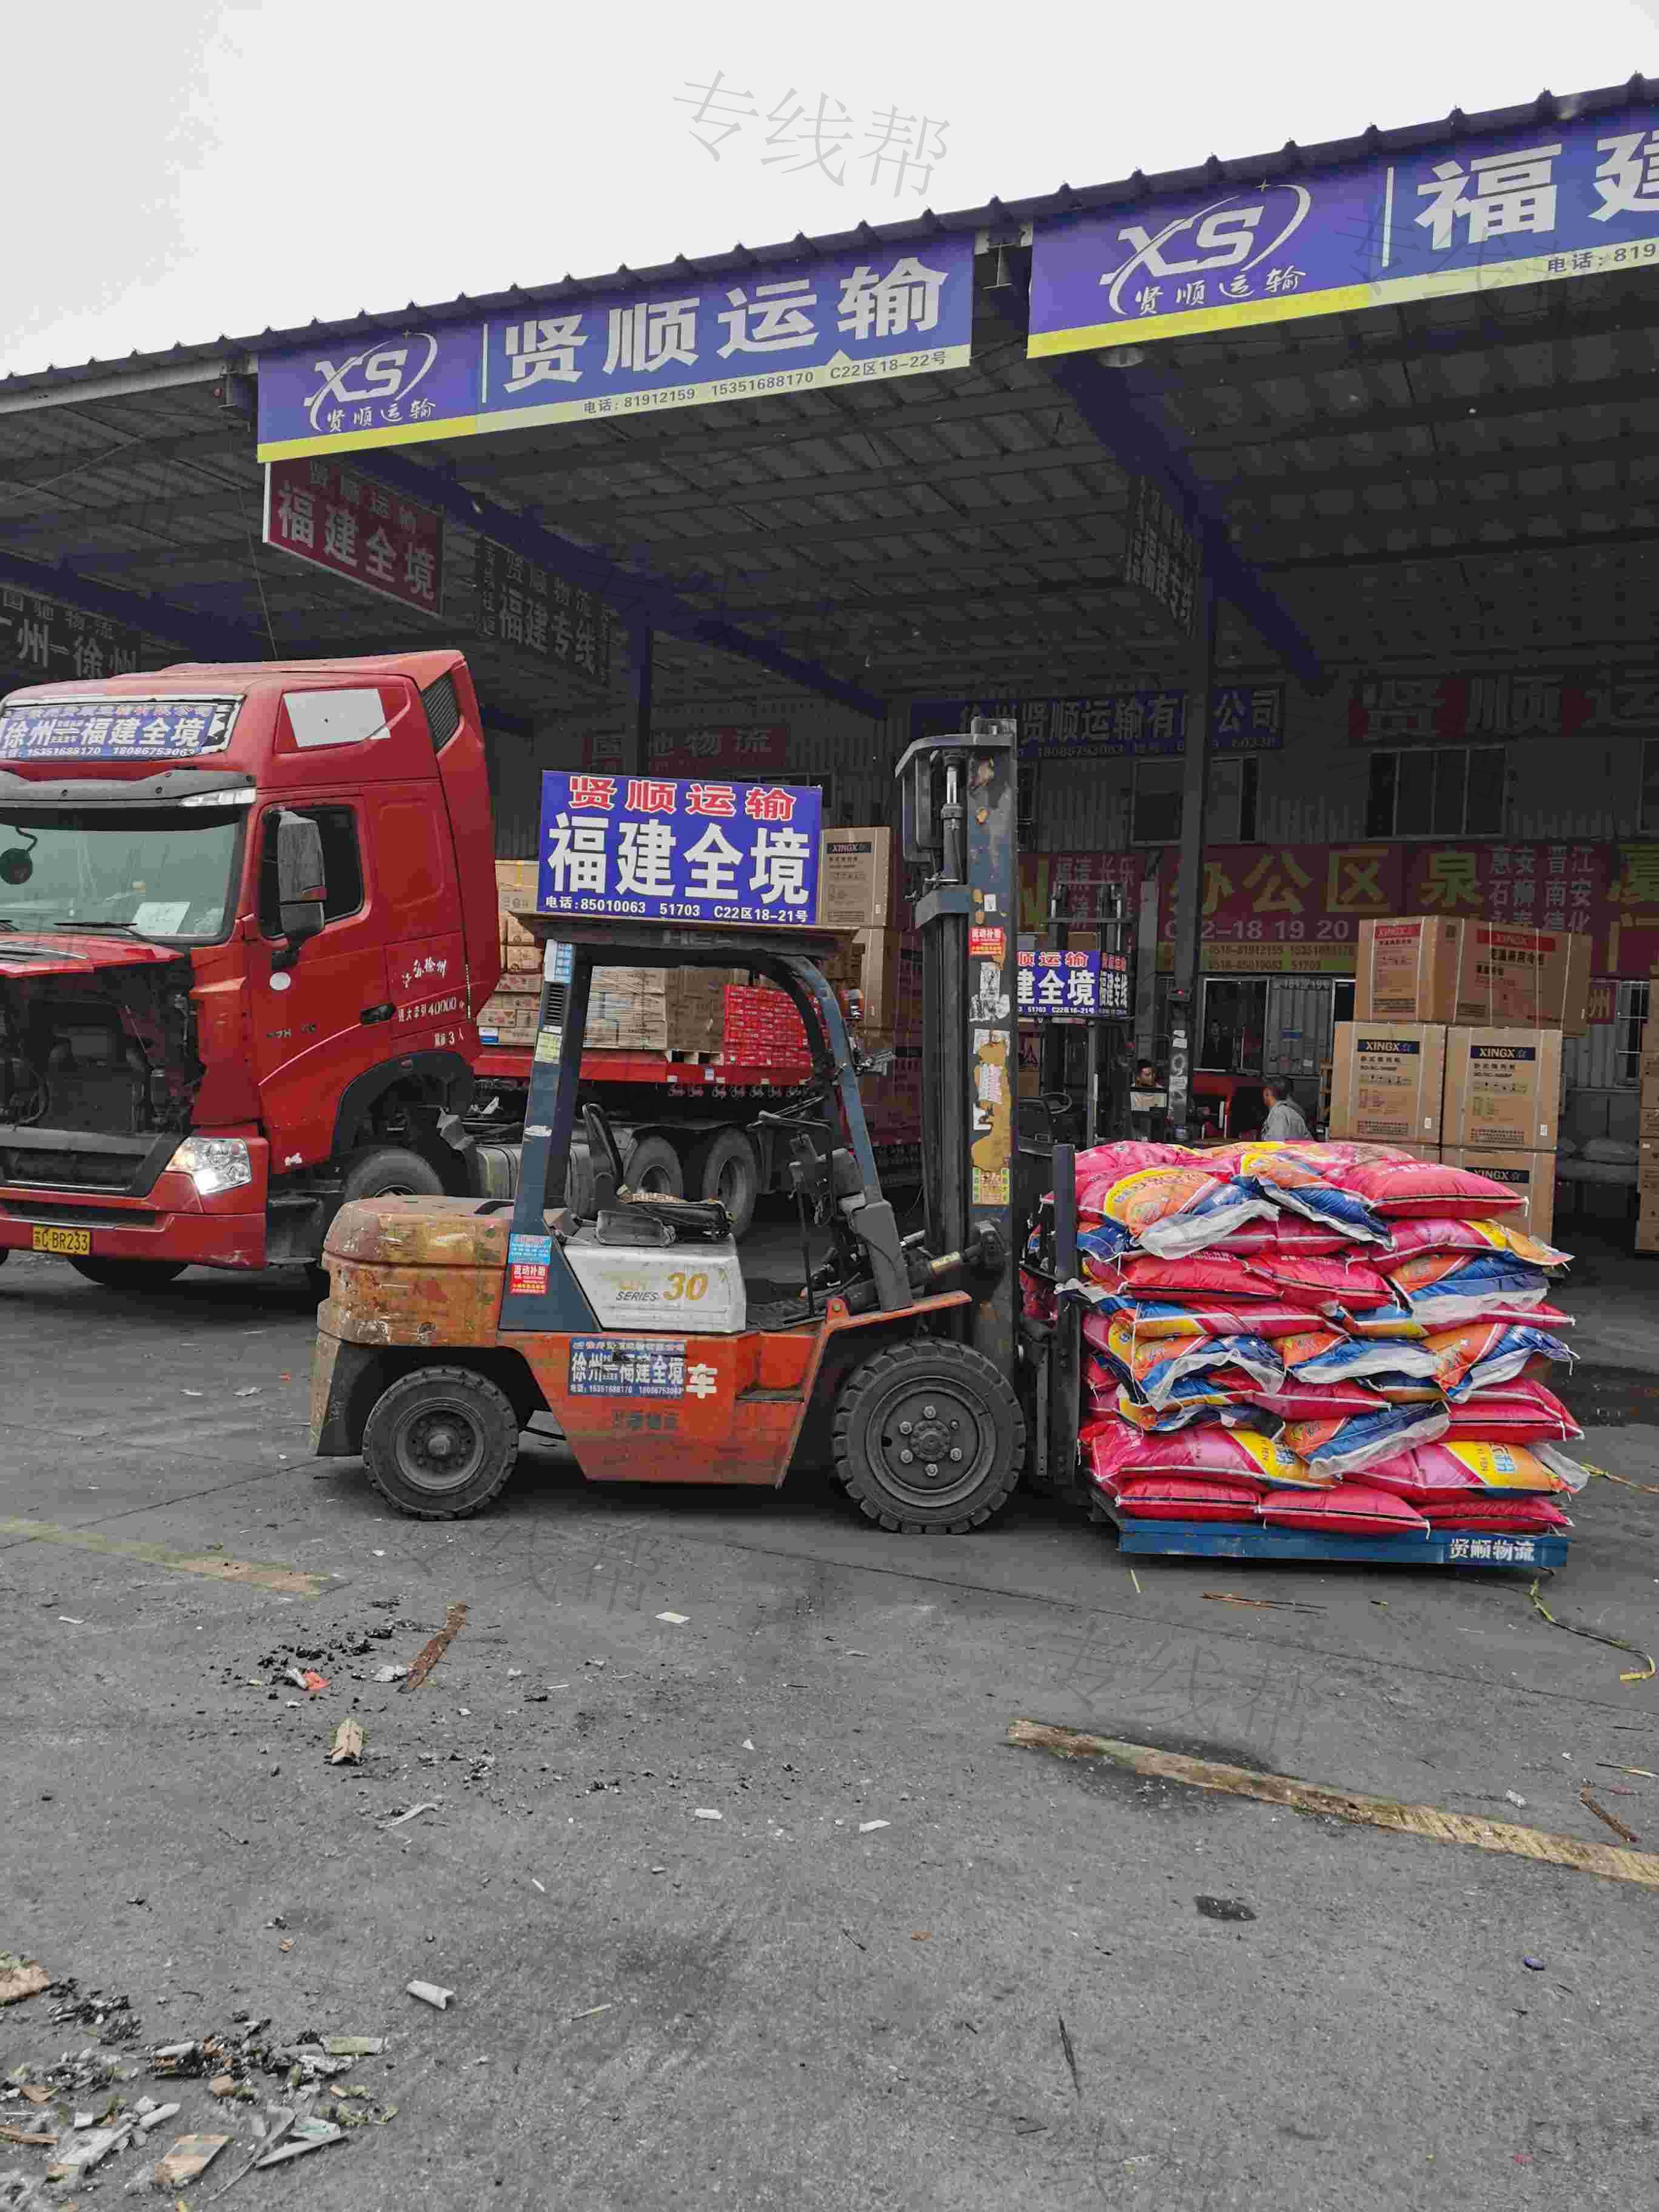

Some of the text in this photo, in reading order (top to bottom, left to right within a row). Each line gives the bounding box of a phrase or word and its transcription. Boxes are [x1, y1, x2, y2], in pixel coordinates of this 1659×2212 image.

[1134, 266, 1307, 315] 贤顺运输
[504, 257, 948, 394] 贤顺运输
[711, 371, 814, 397] 15351688170
[829, 350, 947, 380] C22区18-22号
[325, 397, 437, 433] 贤顺运输
[277, 480, 435, 601] 福建全境
[81, 717, 206, 747] 福建全境
[569, 775, 797, 821] 贤顺运输
[548, 812, 811, 904] 福建全境
[1544, 878, 1592, 908] 南安
[659, 903, 701, 917] 51703
[714, 905, 808, 923] C22区18-21号
[1275, 919, 1305, 940] 19
[1316, 919, 1350, 940] 20
[1480, 1047, 1515, 1058] XINGX
[616, 1290, 659, 1302] SERIES
[663, 1271, 711, 1301] 30
[686, 1363, 718, 1399] 车
[1449, 1538, 1535, 1563] 贤顺物流
